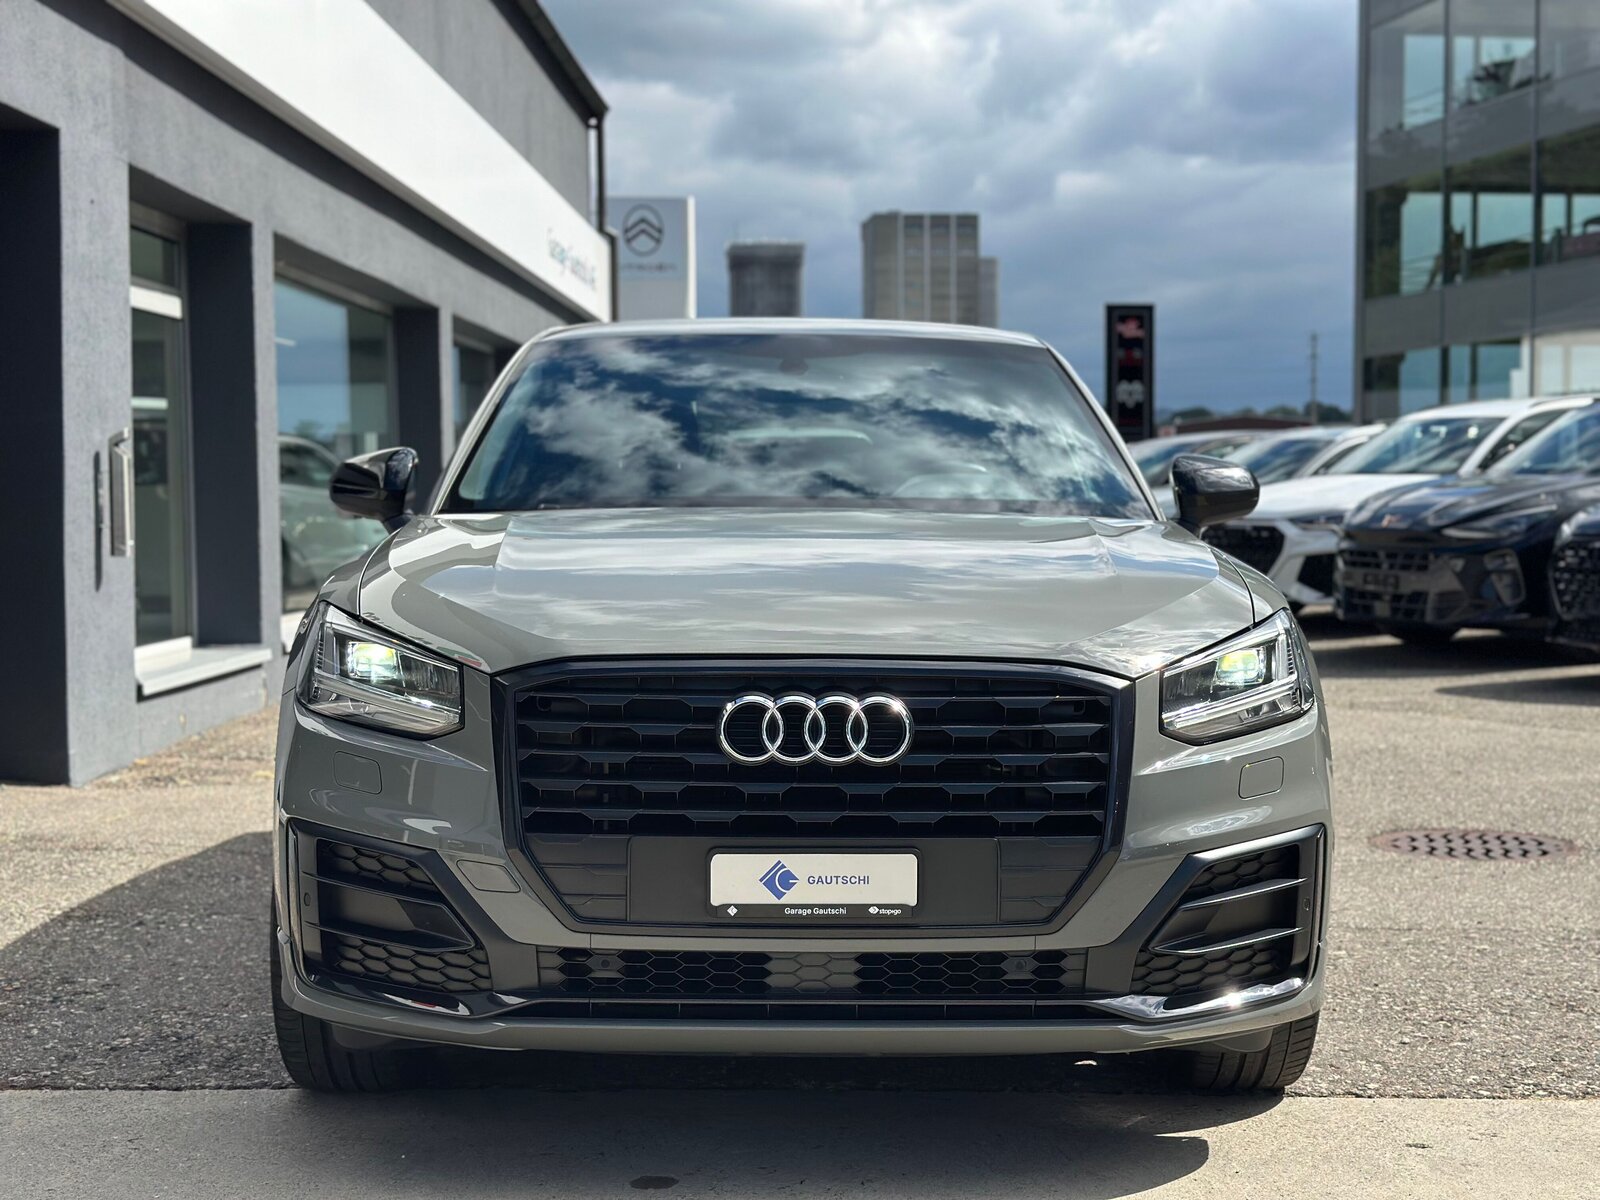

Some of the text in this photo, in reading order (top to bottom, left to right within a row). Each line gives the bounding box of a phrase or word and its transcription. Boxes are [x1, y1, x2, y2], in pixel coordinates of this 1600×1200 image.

[807, 875, 870, 885] GAUTSCHI
[784, 906, 847, 916] Garage Gautschi
